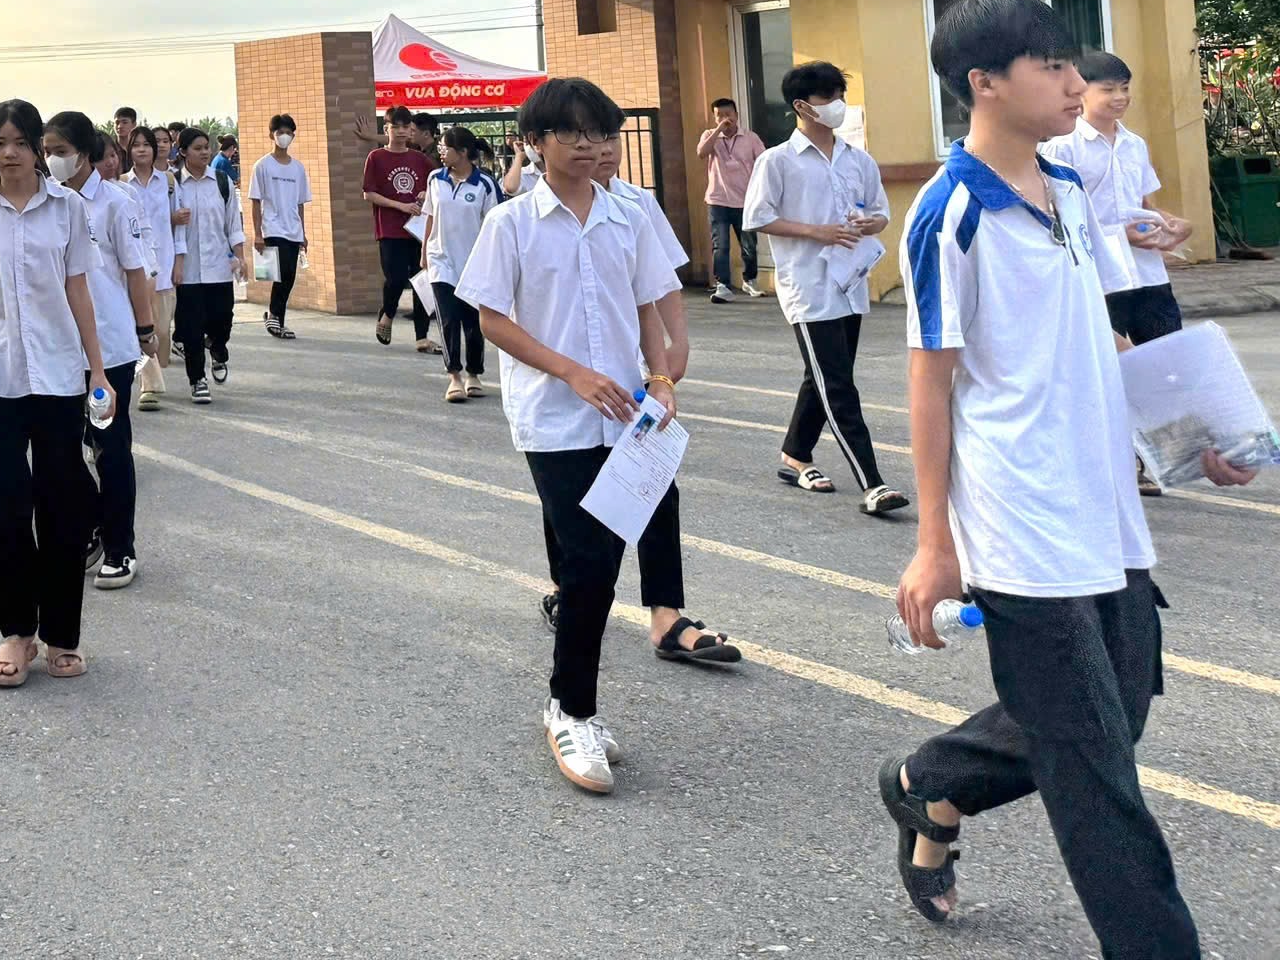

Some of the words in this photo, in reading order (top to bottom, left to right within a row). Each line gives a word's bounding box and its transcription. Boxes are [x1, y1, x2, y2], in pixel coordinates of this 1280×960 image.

[405, 87, 435, 99] VUA
[439, 83, 481, 101] ĐỘNG
[484, 84, 506, 97] CƠ
